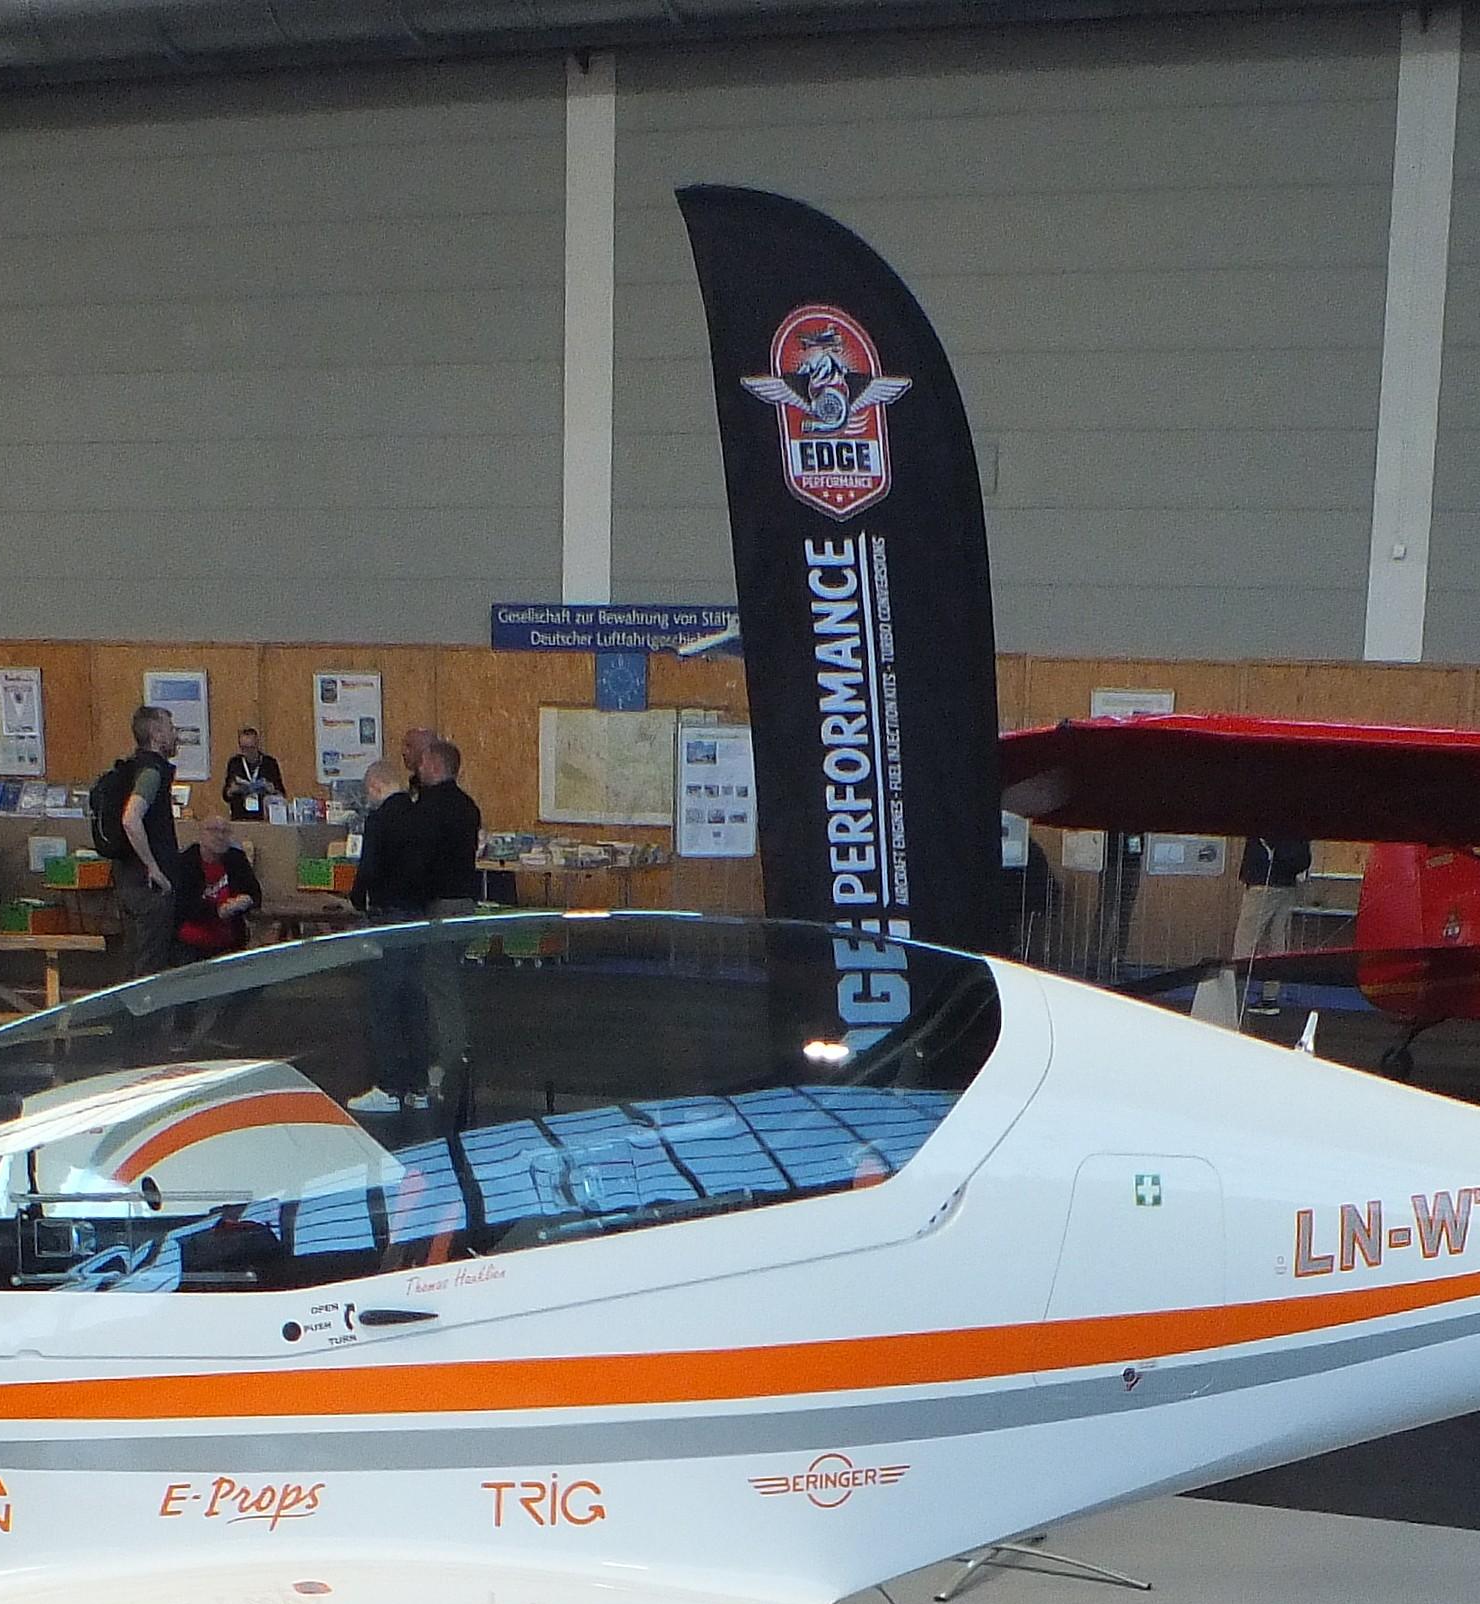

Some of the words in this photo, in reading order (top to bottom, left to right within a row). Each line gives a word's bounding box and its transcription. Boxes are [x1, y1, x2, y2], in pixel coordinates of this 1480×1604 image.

[800, 441, 872, 473] EDGE
[802, 474, 873, 489] PERFORMANCE
[498, 608, 571, 625] Gesellschaft
[575, 612, 595, 625] zur
[599, 610, 669, 630] Bewahrung
[673, 613, 697, 626] von
[530, 631, 592, 646] Deutscher
[804, 537, 878, 905] PERFORMANCE
[887, 764, 902, 791] FUEL
[310, 1302, 339, 1315] OPEN
[328, 1335, 357, 1346] TURN
[748, 1468, 878, 1495] BERINGER
[159, 1476, 326, 1531] E-Props
